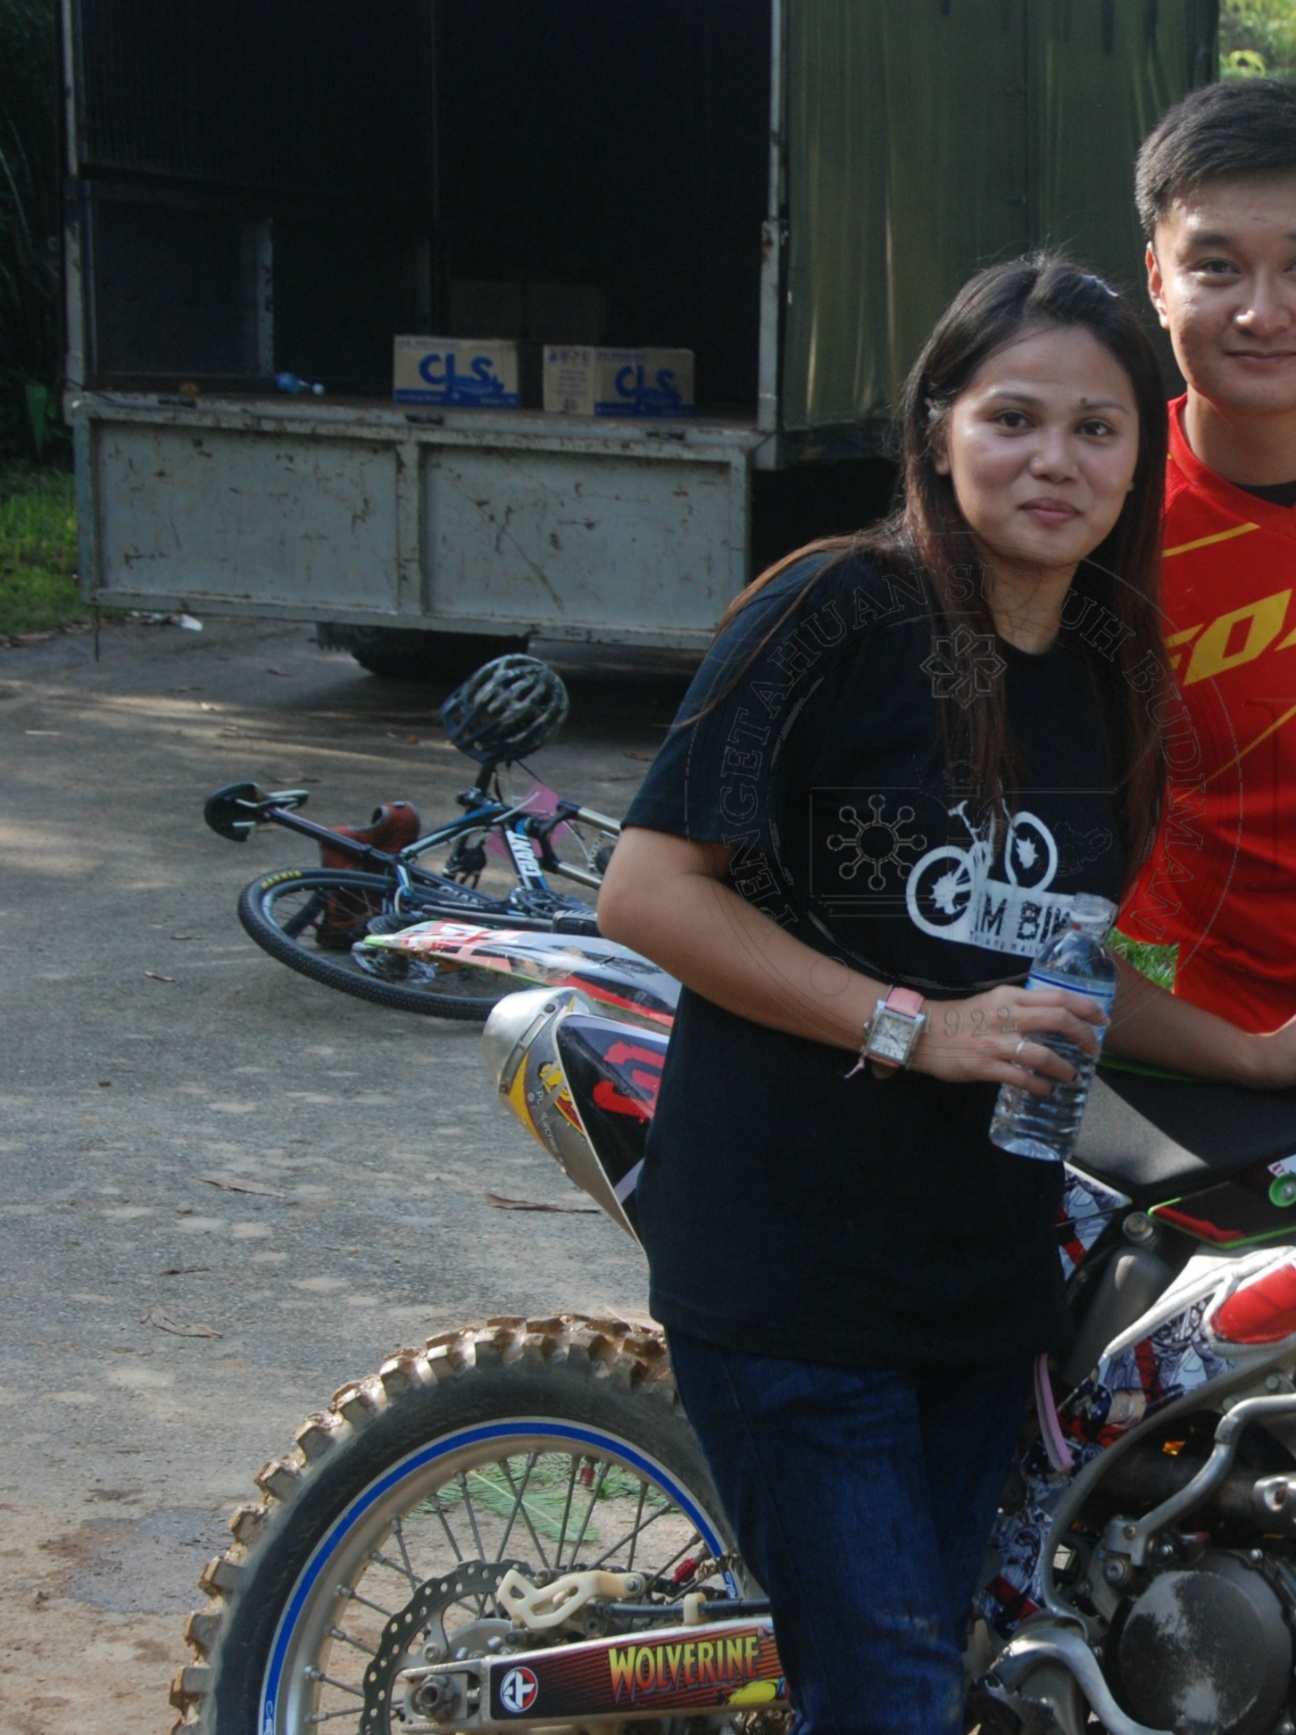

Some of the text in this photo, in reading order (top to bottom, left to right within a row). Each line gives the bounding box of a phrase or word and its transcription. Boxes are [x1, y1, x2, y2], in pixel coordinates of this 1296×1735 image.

[506, 830, 541, 878] GIANT
[1016, 899, 1071, 945] BIK
[608, 1636, 760, 1699] WOLVERINE
